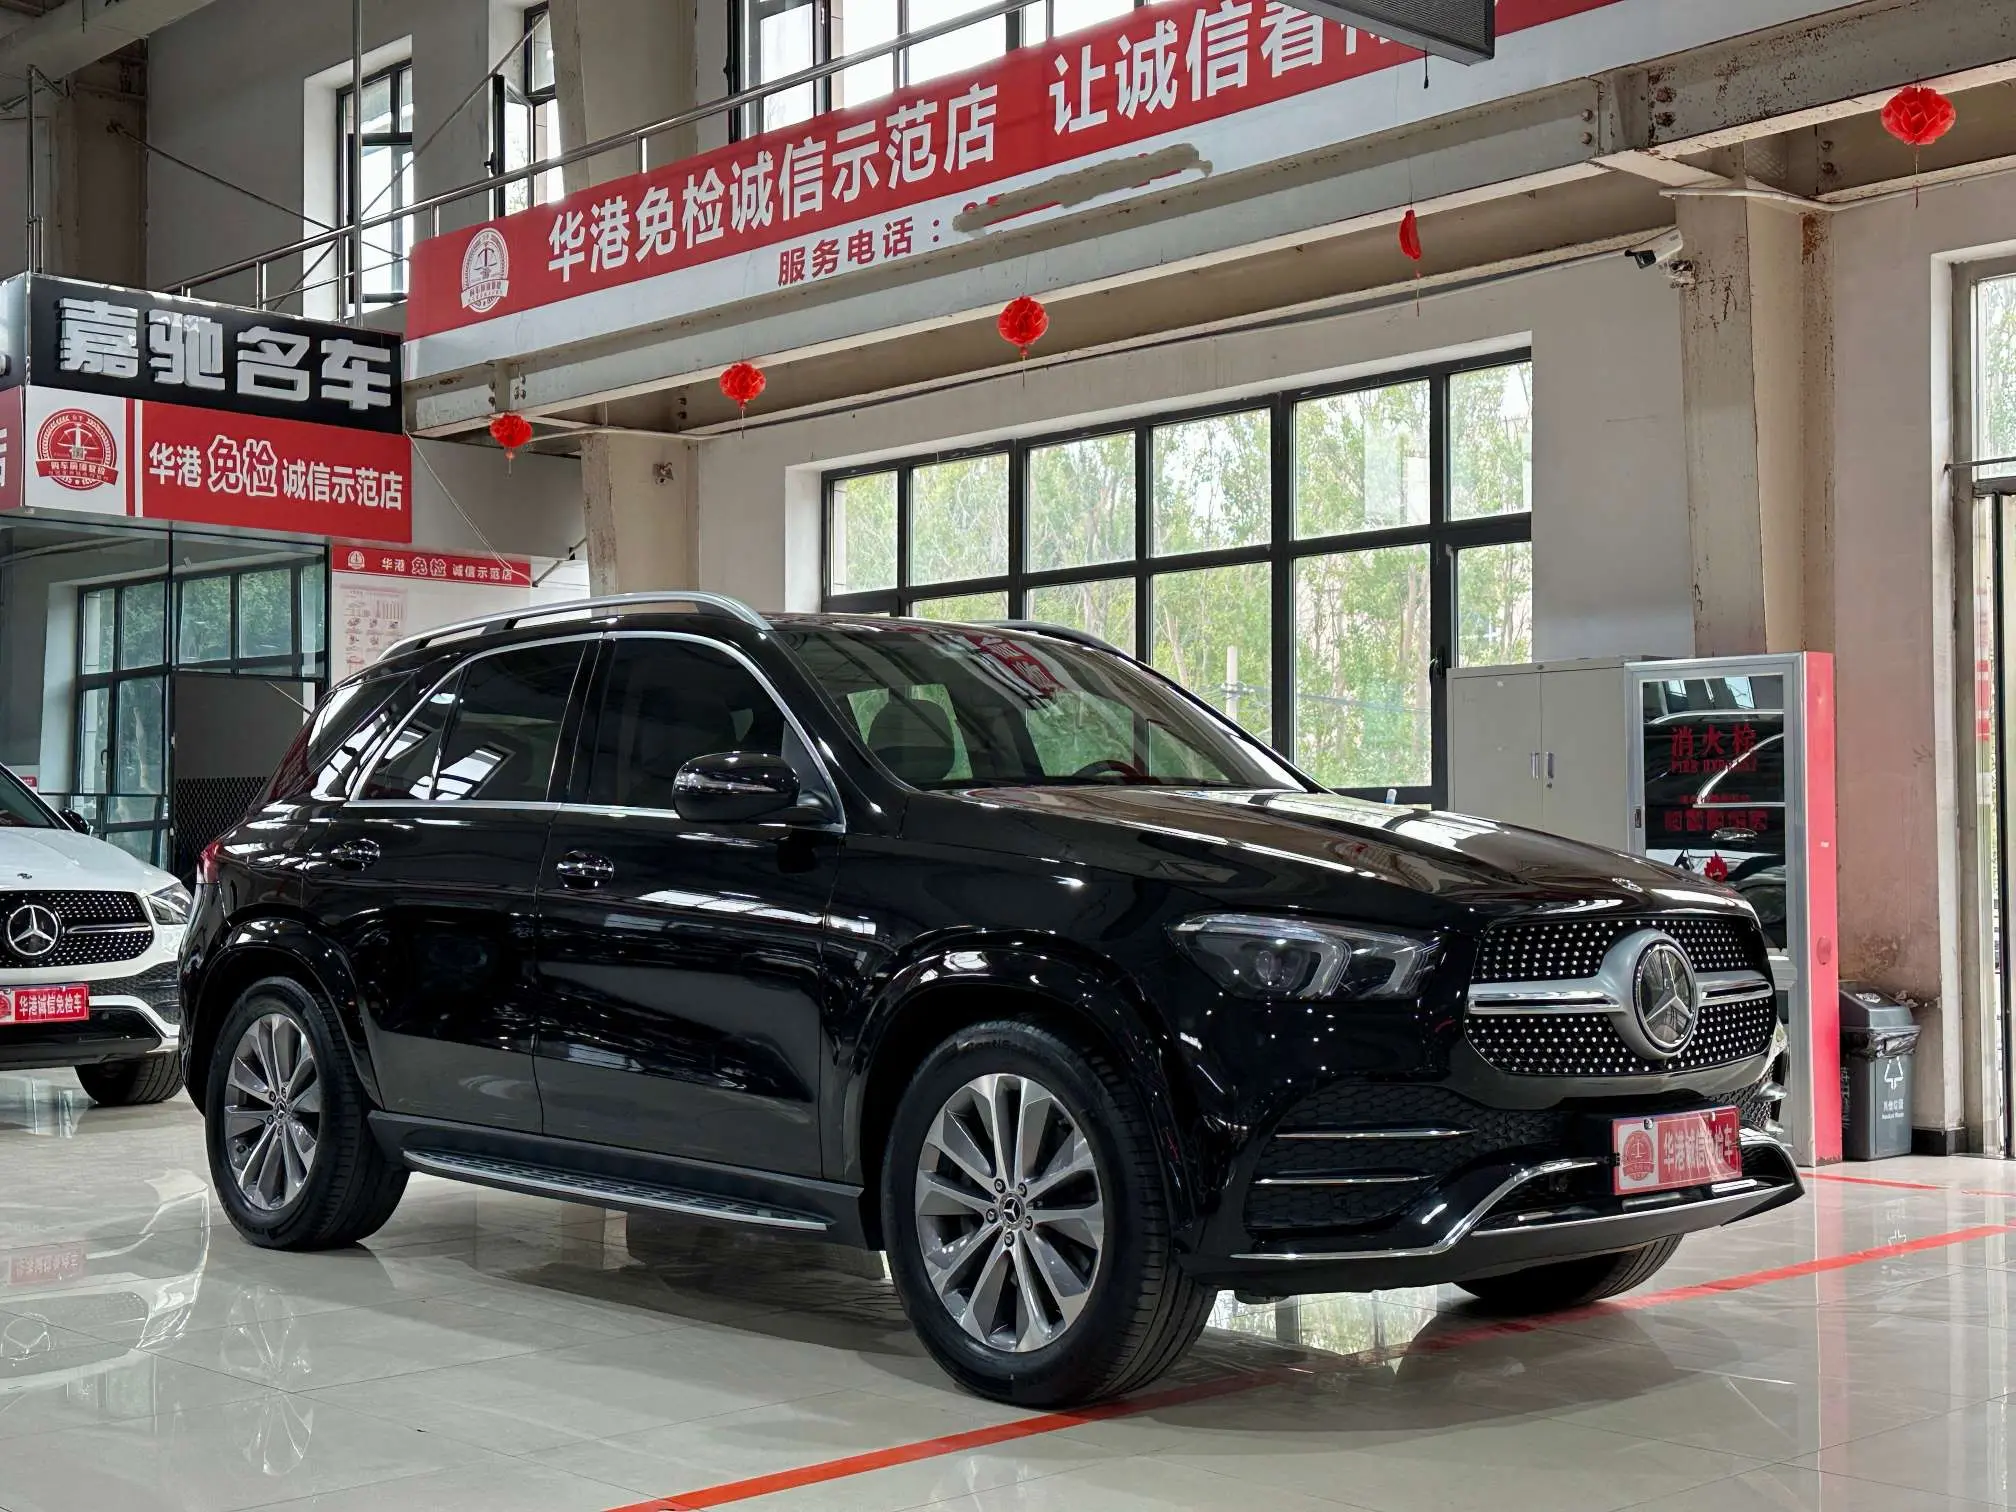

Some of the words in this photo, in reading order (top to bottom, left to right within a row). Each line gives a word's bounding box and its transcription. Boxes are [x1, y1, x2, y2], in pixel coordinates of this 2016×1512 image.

[548, 83, 998, 283] 华港免检诚信示范店
[59, 296, 392, 411] 嘉驰名车
[19, 993, 82, 1016] 华港诚信免检车
